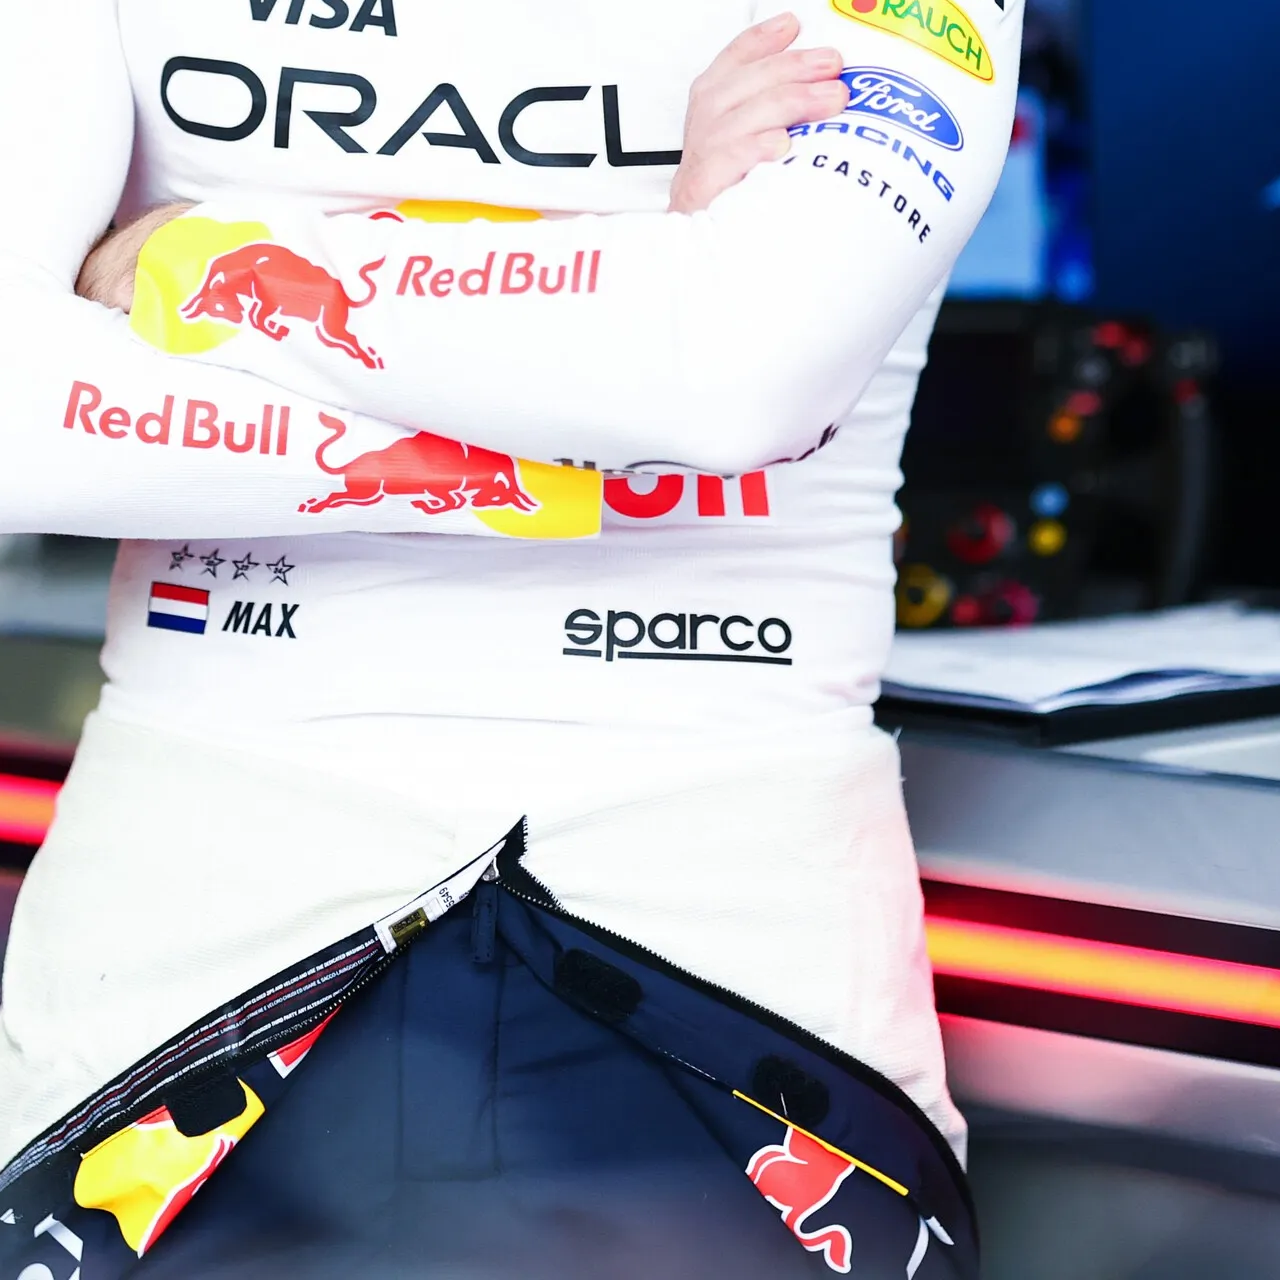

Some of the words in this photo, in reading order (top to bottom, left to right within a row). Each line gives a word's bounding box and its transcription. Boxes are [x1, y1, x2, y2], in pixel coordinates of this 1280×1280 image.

[160, 55, 685, 168] ORACL
[847, 73, 942, 132] Ford
[812, 154, 931, 244] CASTORE
[396, 253, 488, 295] Red
[500, 250, 602, 295] Bull
[62, 380, 174, 447] Red
[183, 398, 290, 457] Bull
[221, 600, 300, 639] MAX
[564, 607, 793, 662] sparco
